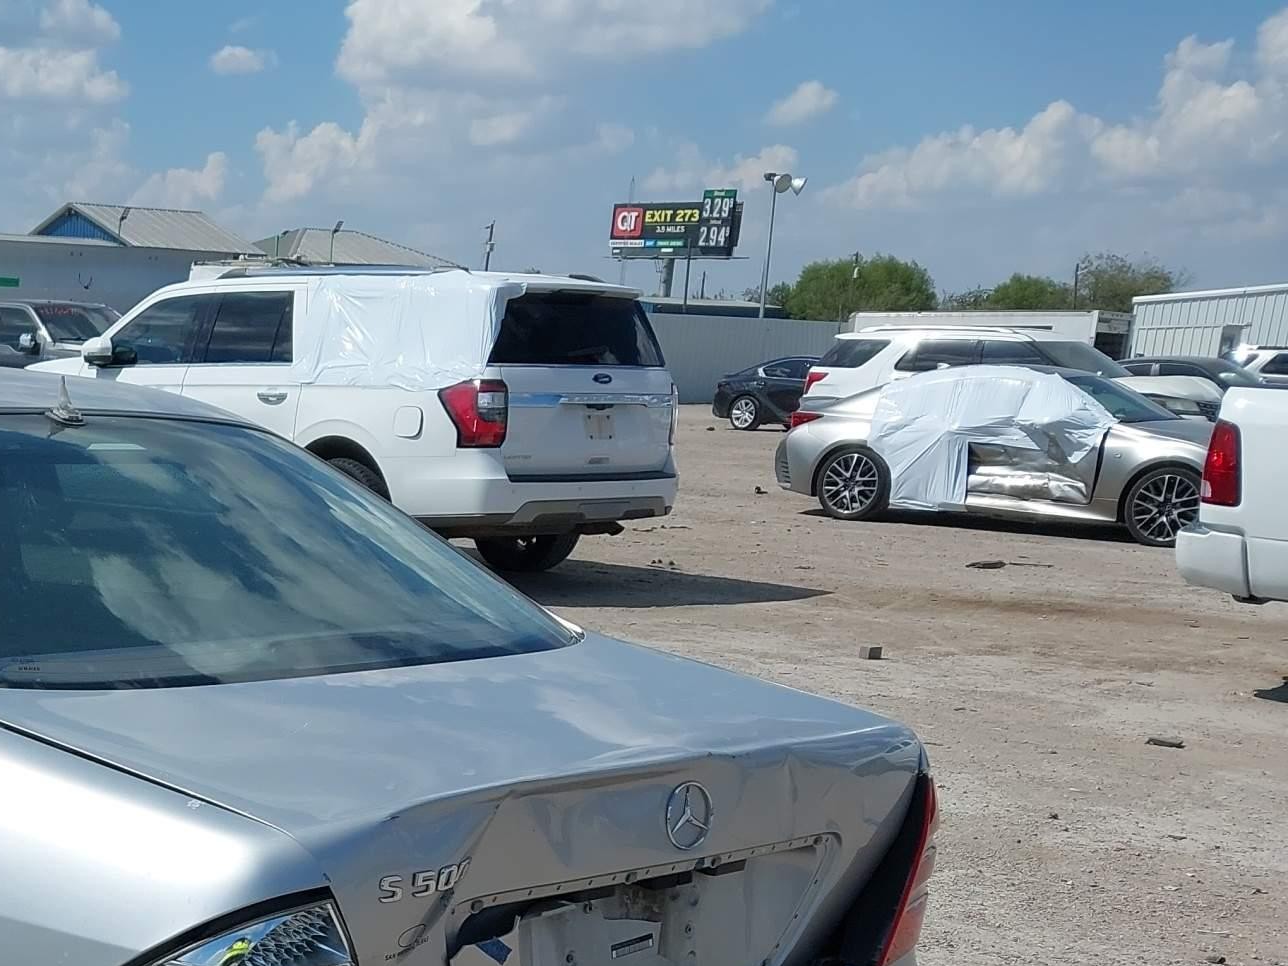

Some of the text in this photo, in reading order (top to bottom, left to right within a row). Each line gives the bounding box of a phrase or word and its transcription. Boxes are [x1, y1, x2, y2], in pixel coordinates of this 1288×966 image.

[645, 209, 700, 222] EXIT 273
[666, 225, 685, 233] MILES
[379, 874, 403, 903] S
